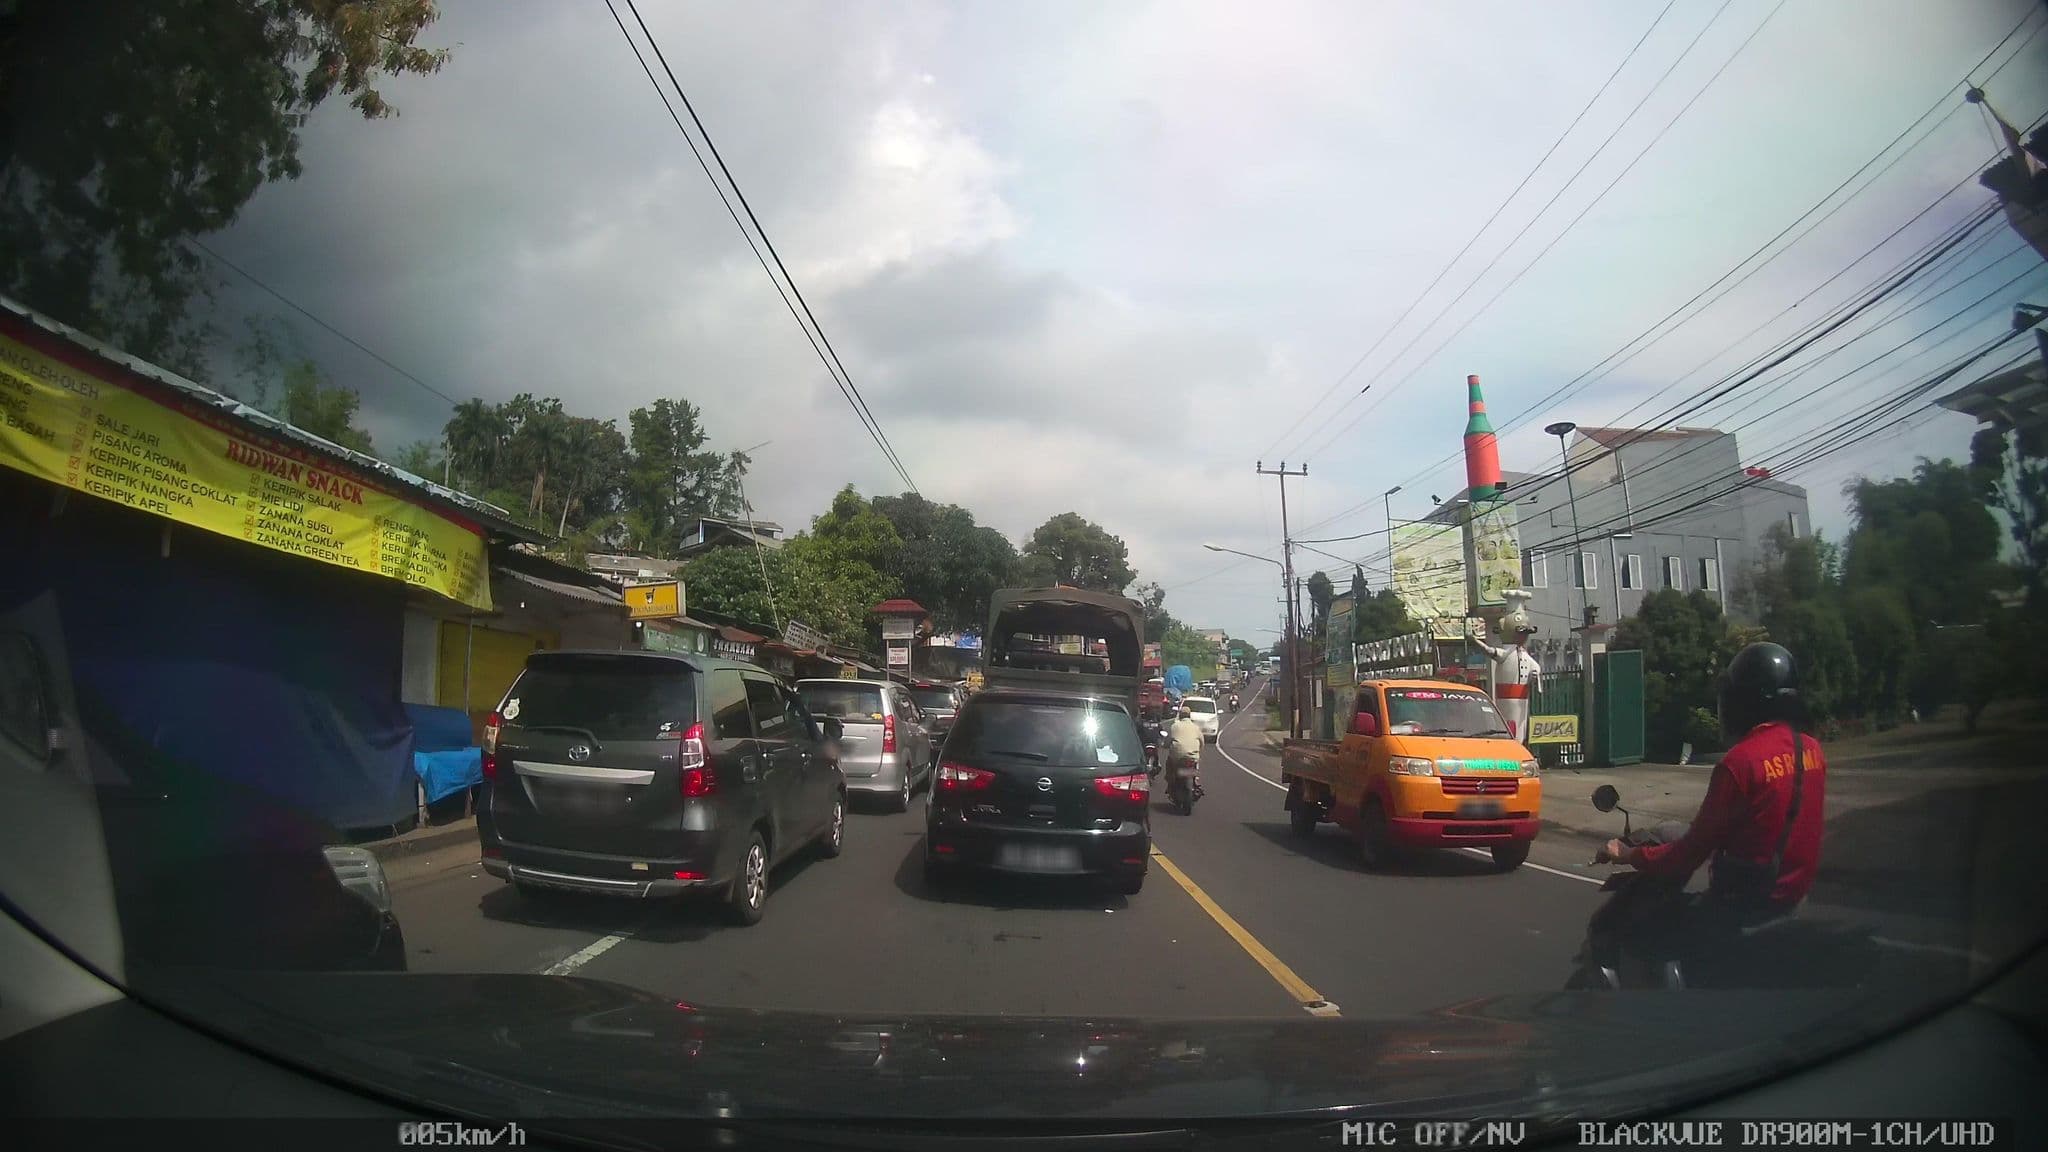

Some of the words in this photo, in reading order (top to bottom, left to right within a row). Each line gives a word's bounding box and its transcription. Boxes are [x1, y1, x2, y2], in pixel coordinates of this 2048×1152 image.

[21, 358, 58, 383] OLEH
[61, 375, 99, 399] OLEH
[96, 413, 129, 436] SALE
[132, 429, 160, 447] JARI
[92, 430, 141, 456] PISANG
[143, 453, 187, 475] AROMA
[85, 462, 138, 488] KERIPIK
[140, 482, 194, 508] NANGKA
[89, 446, 142, 474] KERIPIK
[143, 466, 189, 490] PISANG
[191, 482, 238, 506] COKLAT
[226, 439, 305, 483] RIDWAN
[306, 470, 363, 505] SNACK
[84, 478, 136, 504] KERIPIK
[139, 497, 172, 515] APEL
[261, 491, 282, 507] MIE
[282, 500, 304, 513] LIDI
[263, 478, 307, 501] KERIPIK
[308, 493, 341, 512] SALAK
[257, 518, 303, 539] ZANANA
[305, 532, 344, 550] COKLAT
[259, 505, 305, 526] ZANANA
[307, 519, 333, 535] SUSU
[257, 531, 302, 552] ZANANA
[304, 545, 339, 561] GREEN
[340, 554, 360, 567] TEA
[1531, 720, 1576, 738] BUKA
